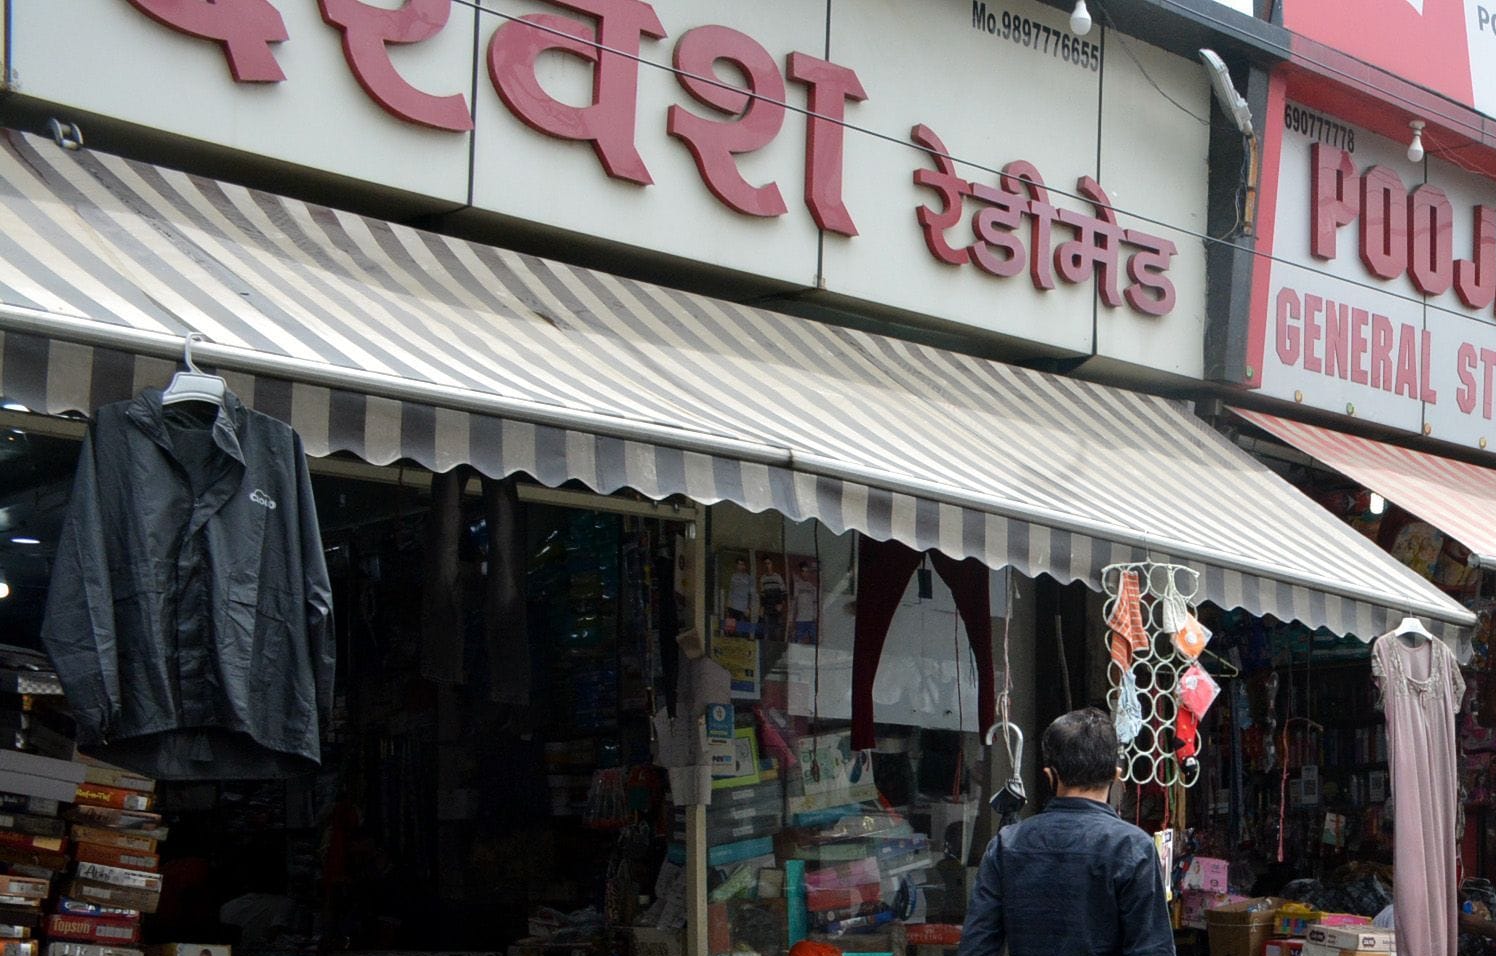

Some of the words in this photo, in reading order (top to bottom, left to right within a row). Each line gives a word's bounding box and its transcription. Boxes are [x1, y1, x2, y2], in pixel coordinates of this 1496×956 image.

[972, 0, 1099, 72] Mo.9897776655
[911, 123, 1178, 317] रेडीमेड
[1276, 287, 1437, 405] GENERAL
